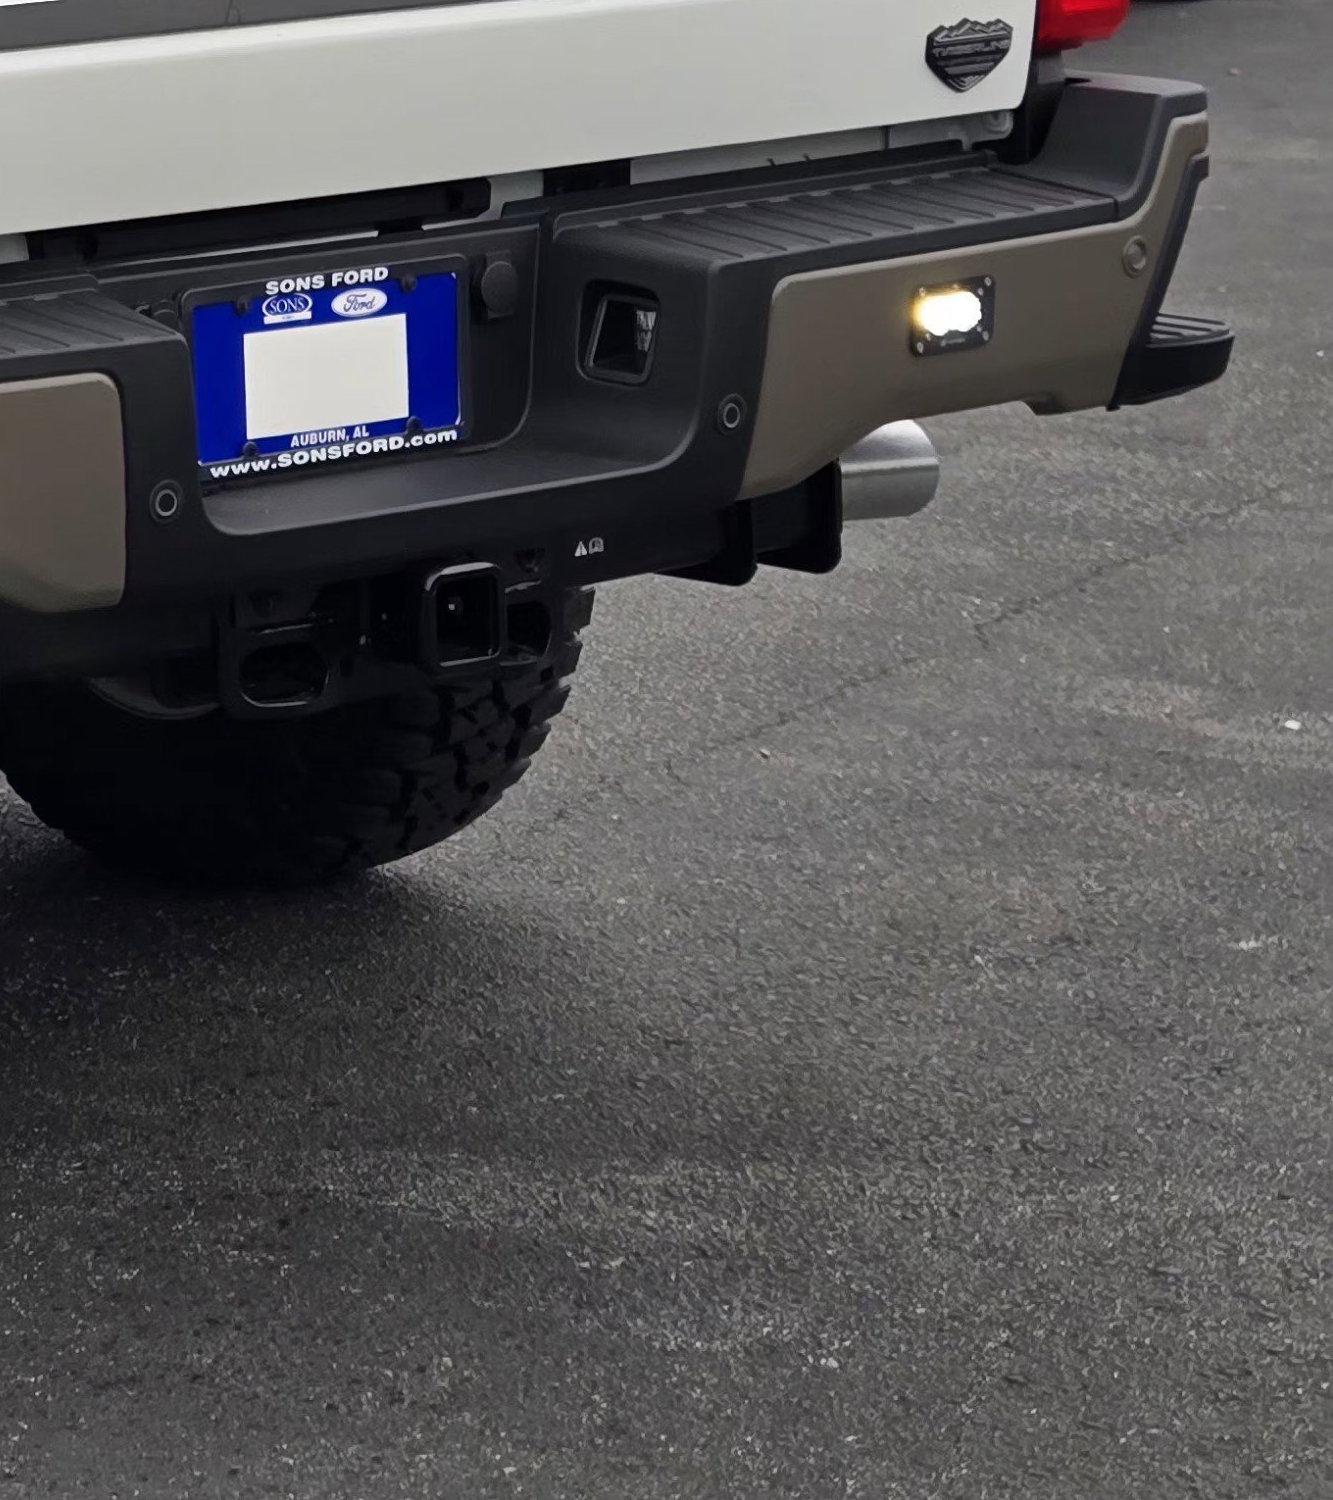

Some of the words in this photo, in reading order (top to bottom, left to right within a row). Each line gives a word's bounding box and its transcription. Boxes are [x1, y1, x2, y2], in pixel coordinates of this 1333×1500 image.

[265, 274, 325, 295] SONS
[331, 267, 389, 287] FORD
[269, 297, 306, 314] SONS
[343, 293, 376, 313] Ford
[290, 428, 350, 448] AUBURN,
[352, 425, 370, 438] AL
[209, 429, 458, 479] www.SONSFORD.com
